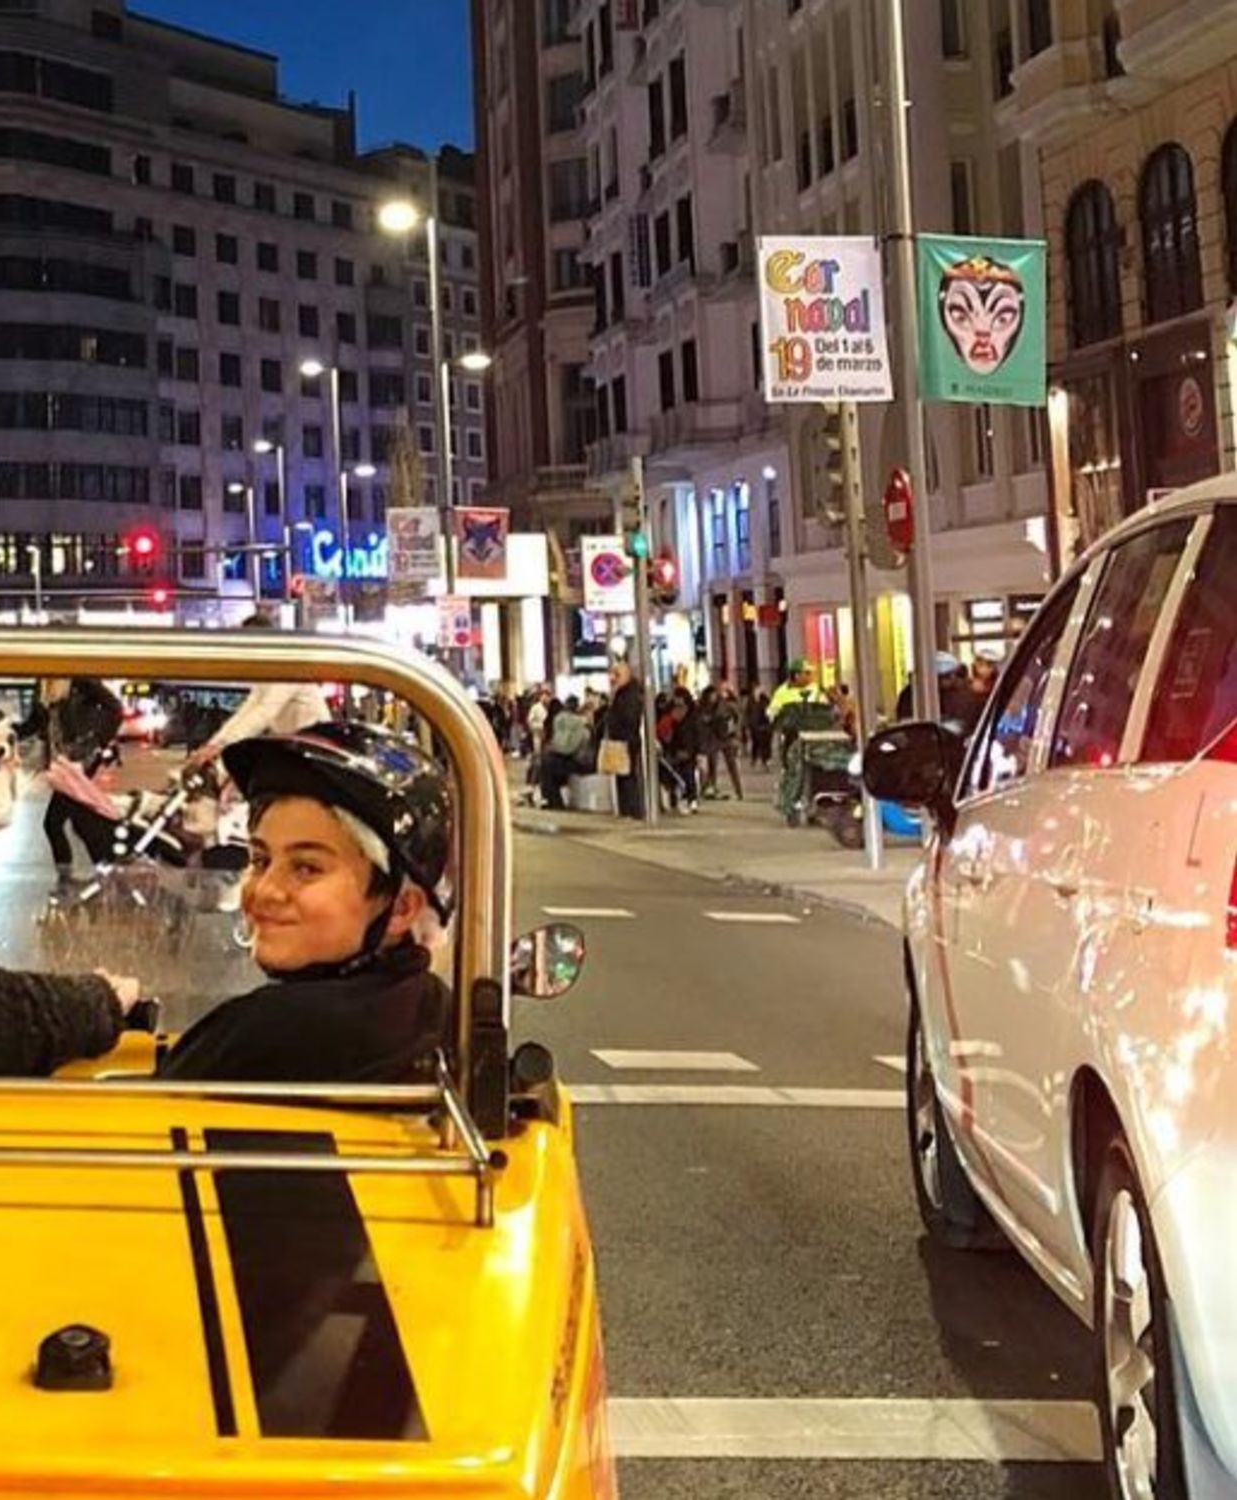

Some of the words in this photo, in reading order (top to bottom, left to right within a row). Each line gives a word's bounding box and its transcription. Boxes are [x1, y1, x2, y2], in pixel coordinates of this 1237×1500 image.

[765, 250, 840, 294] Car
[783, 289, 871, 334] naval
[769, 336, 813, 382] 19
[814, 338, 839, 353] Del
[851, 338, 863, 353] al
[864, 338, 874, 354] 6
[815, 357, 834, 371] de
[836, 358, 883, 371] marzo
